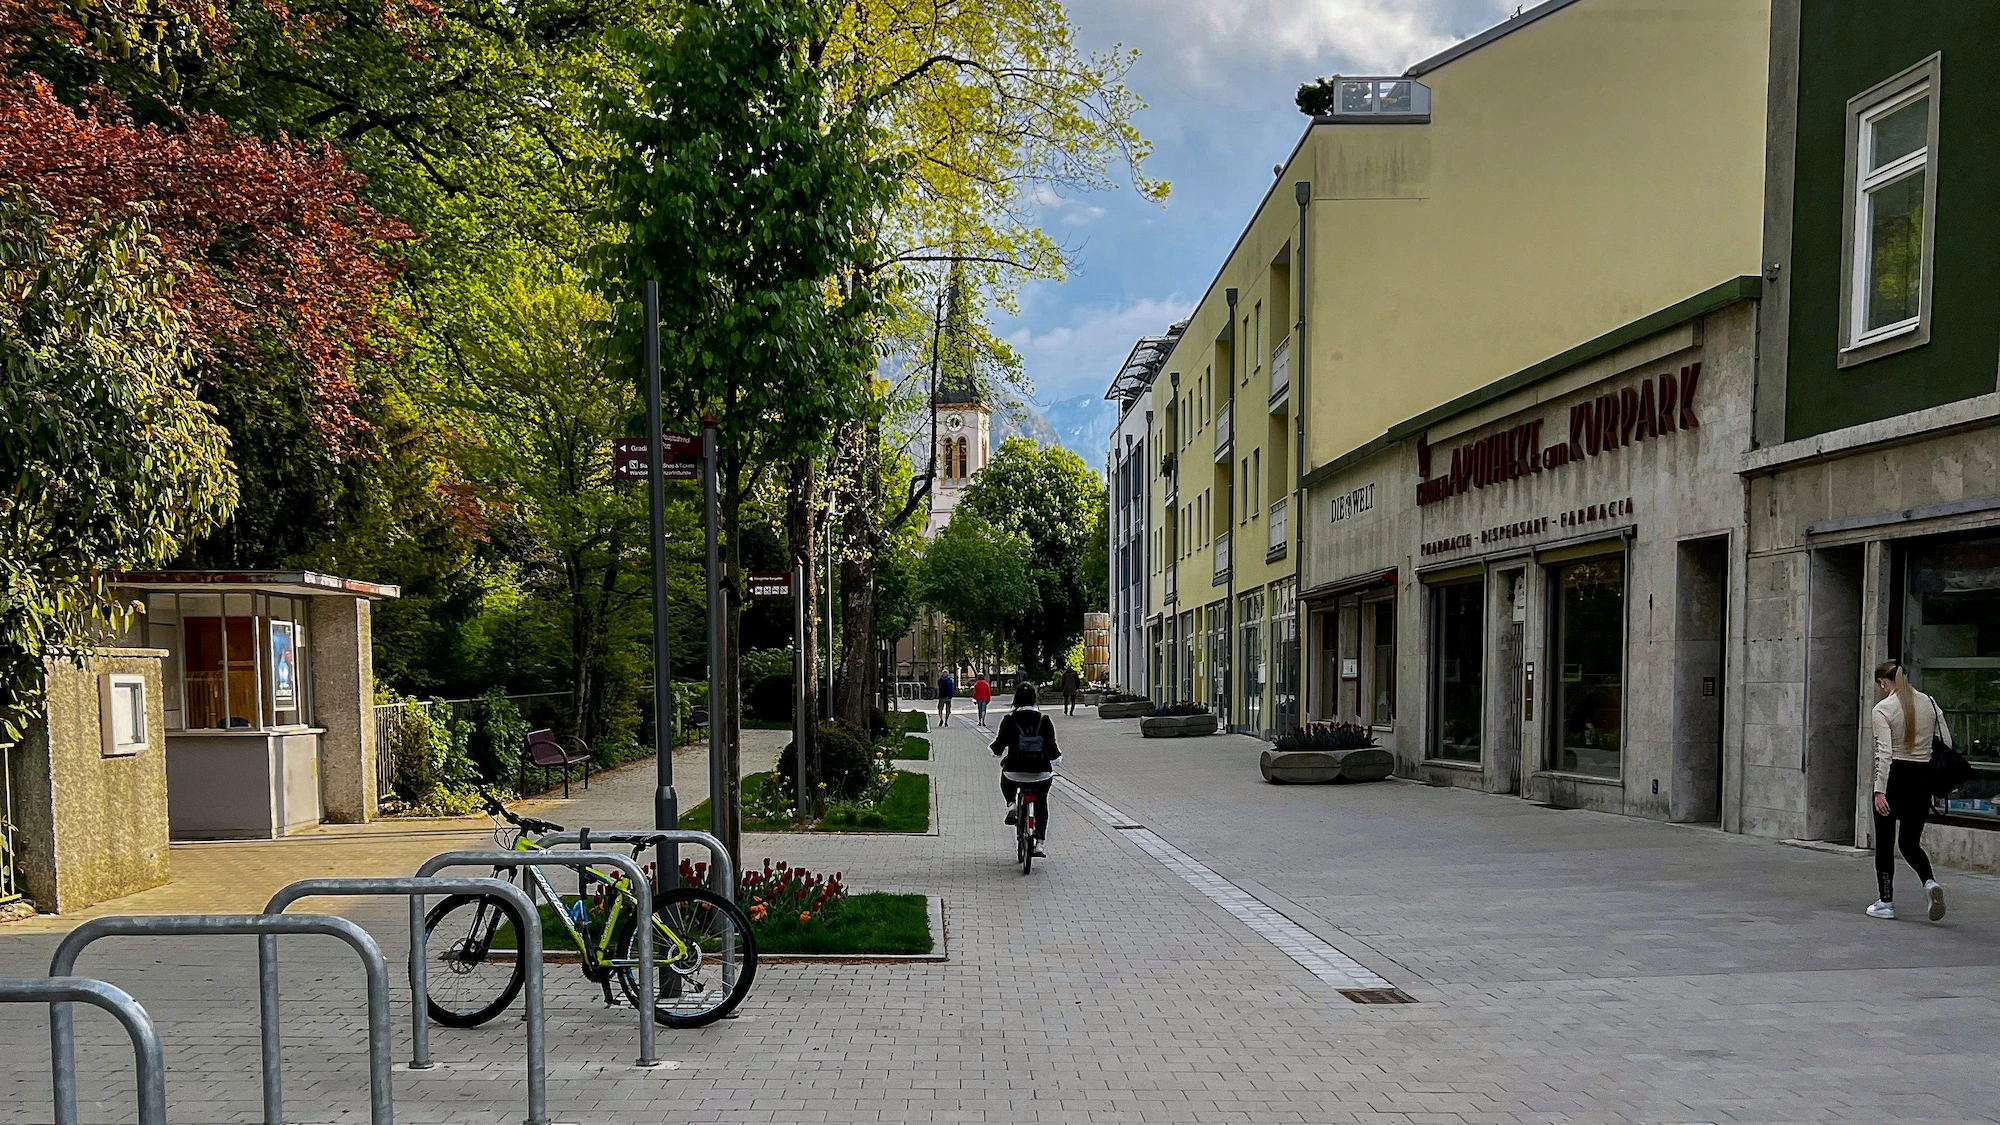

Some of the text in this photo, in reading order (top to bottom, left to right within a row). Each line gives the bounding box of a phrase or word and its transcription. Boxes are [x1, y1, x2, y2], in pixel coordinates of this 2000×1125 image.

[1449, 418, 1544, 496] APOTHEKE
[1543, 442, 1569, 469] am
[1570, 362, 1702, 461] KURPARK
[1331, 483, 1375, 523] DIE WELT
[1420, 534, 1472, 557] PHARMACIE
[1560, 497, 1633, 528] FARMACIA
